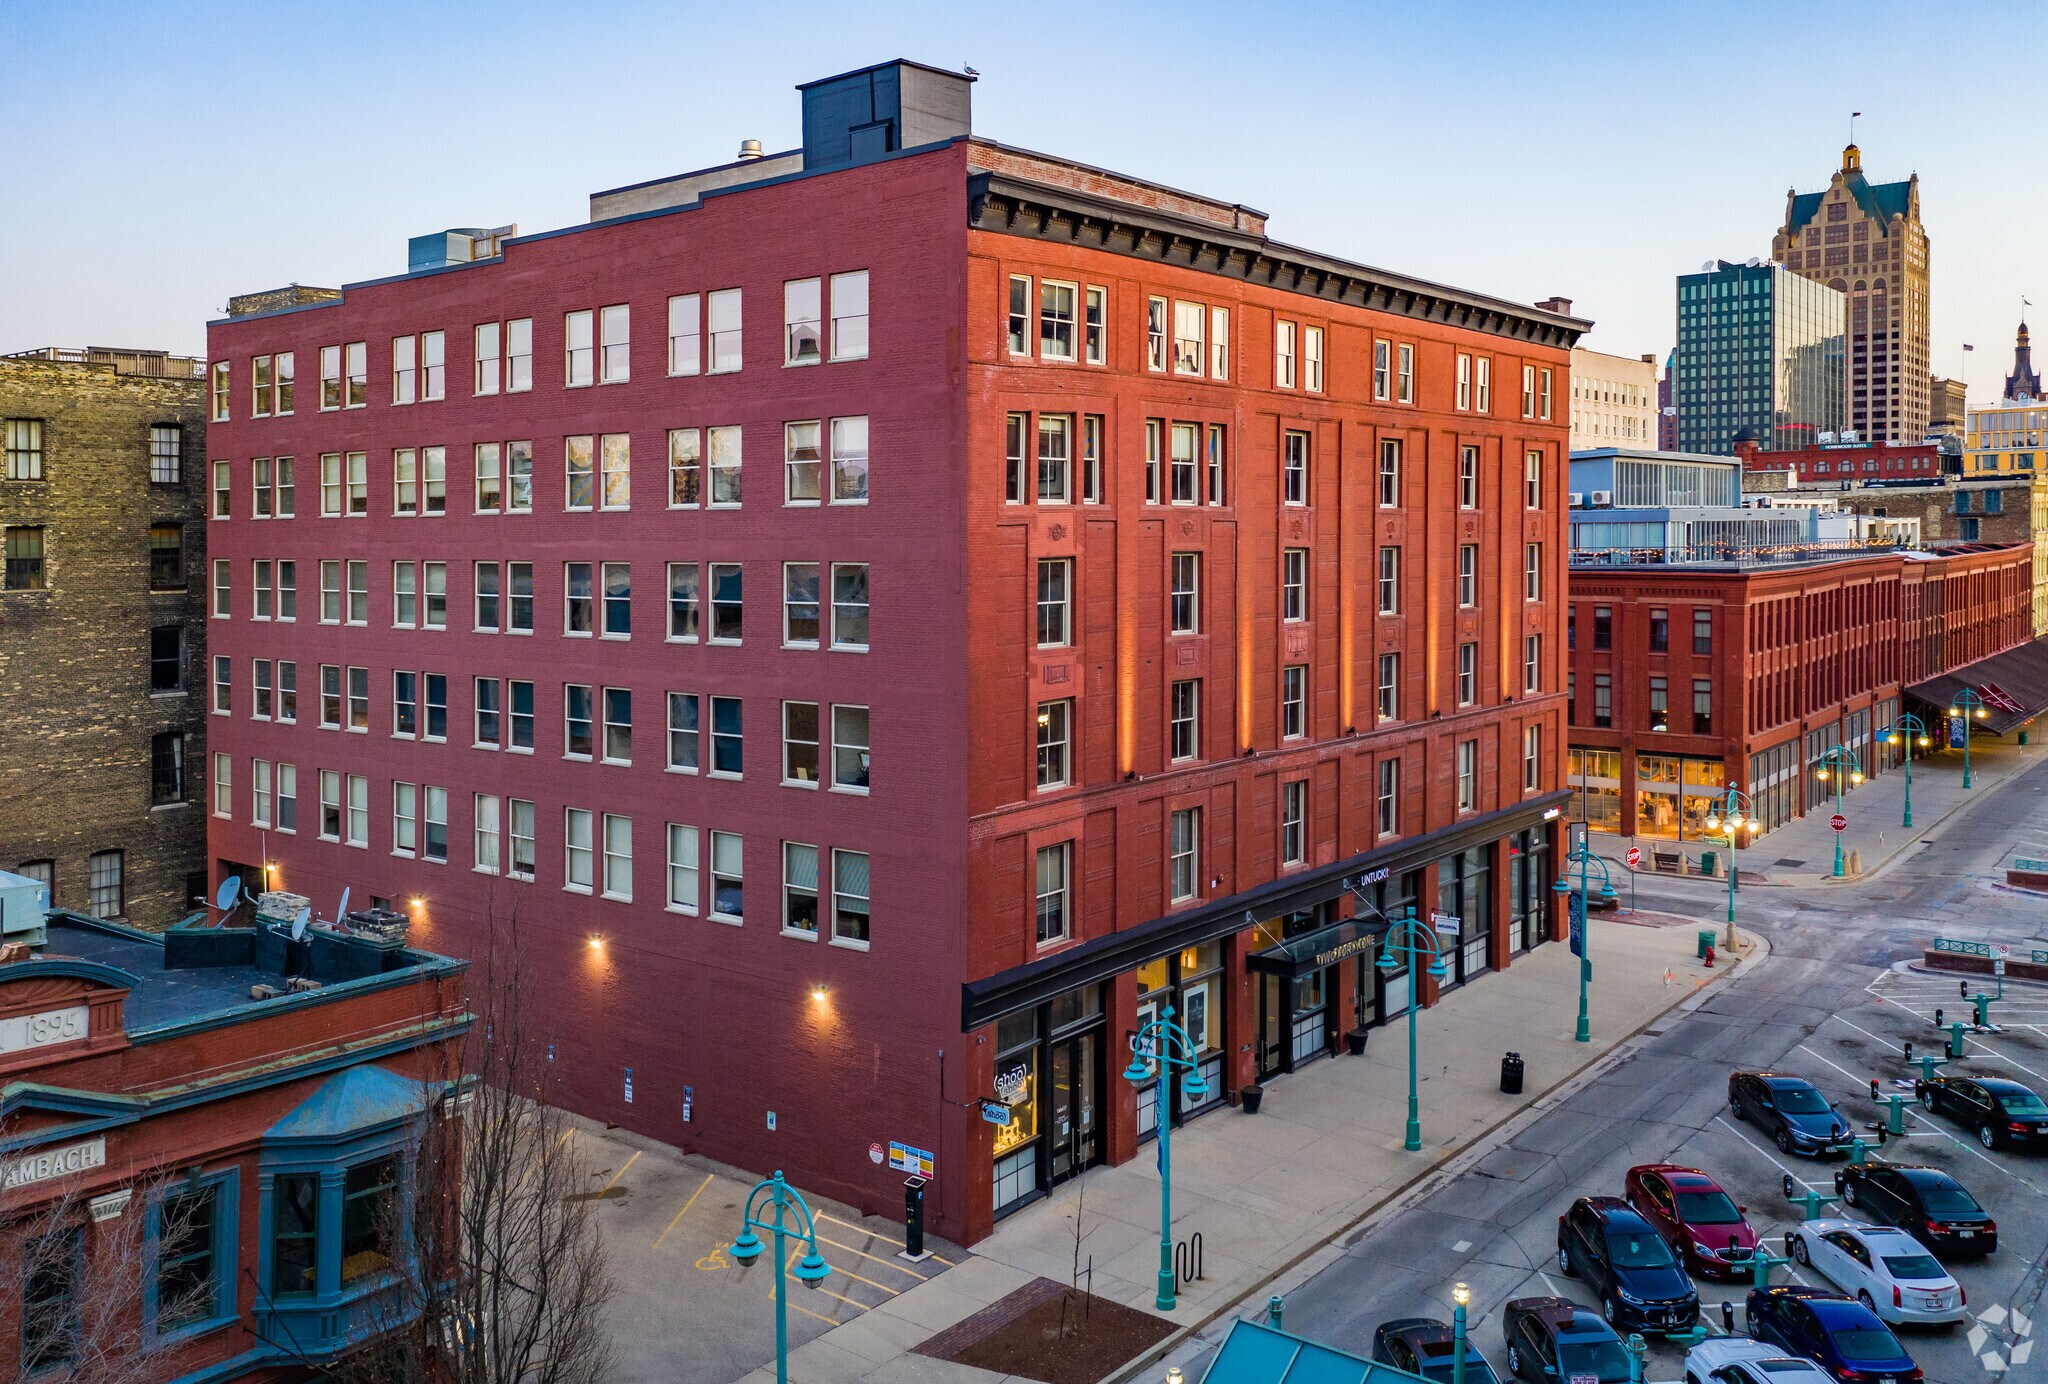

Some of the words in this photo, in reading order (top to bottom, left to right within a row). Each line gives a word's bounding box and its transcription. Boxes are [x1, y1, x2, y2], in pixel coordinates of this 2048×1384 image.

[1830, 818, 1846, 827] STOP
[1627, 852, 1640, 861] STOP
[0, 1145, 100, 1185] AMBACH.
